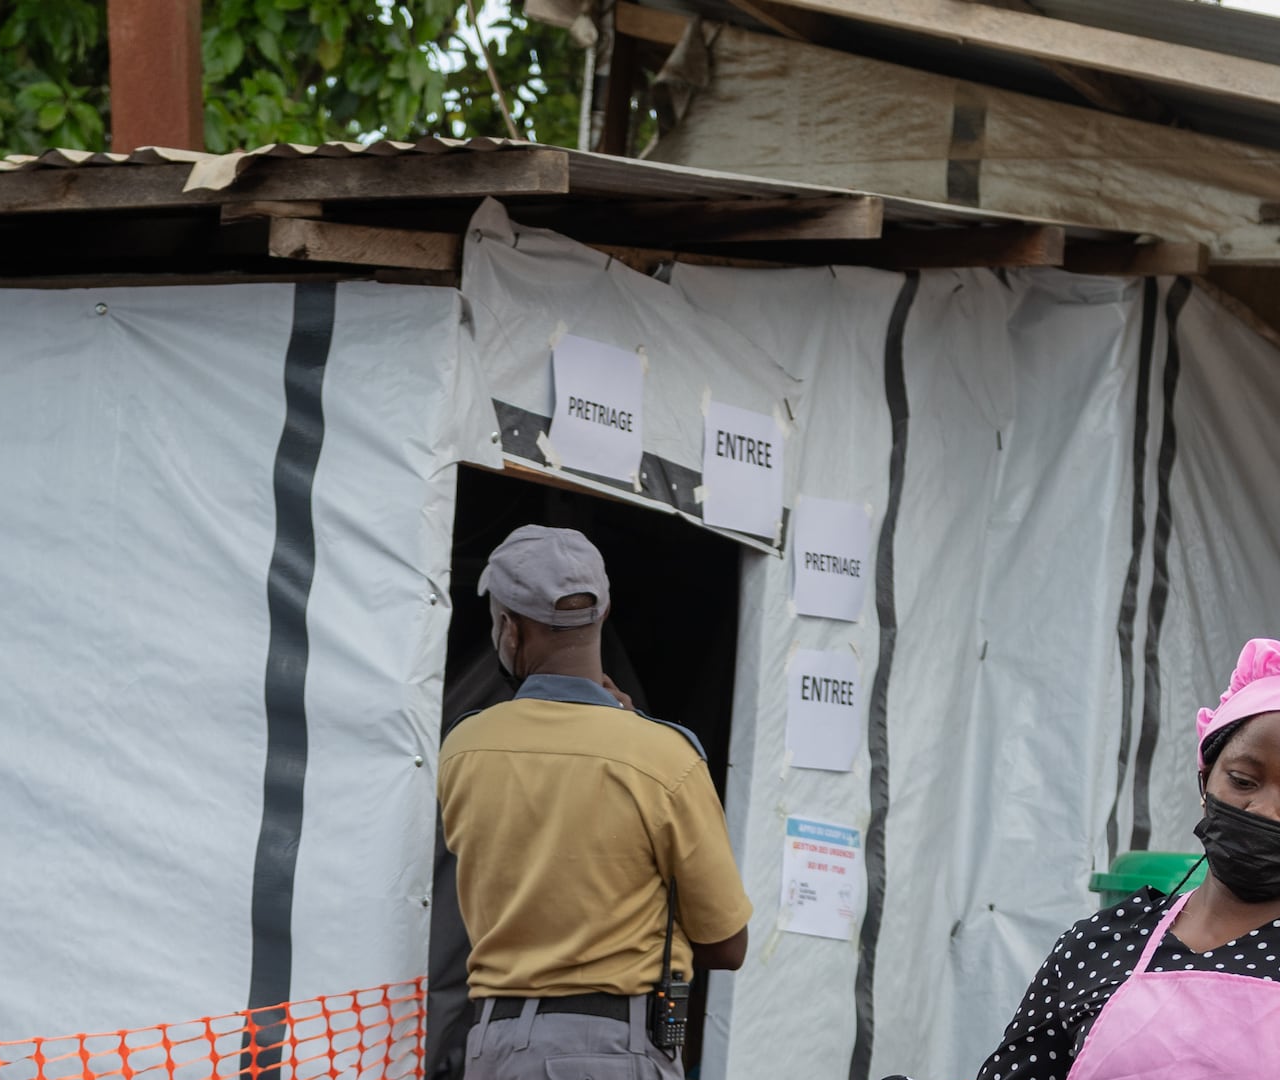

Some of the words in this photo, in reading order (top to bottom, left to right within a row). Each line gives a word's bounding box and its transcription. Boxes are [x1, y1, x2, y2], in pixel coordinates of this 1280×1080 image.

[568, 396, 633, 432] PRETRIAGE
[716, 430, 772, 469] ENTREE
[805, 551, 861, 578] PRETRIAGE
[801, 675, 854, 706] ENTREE
